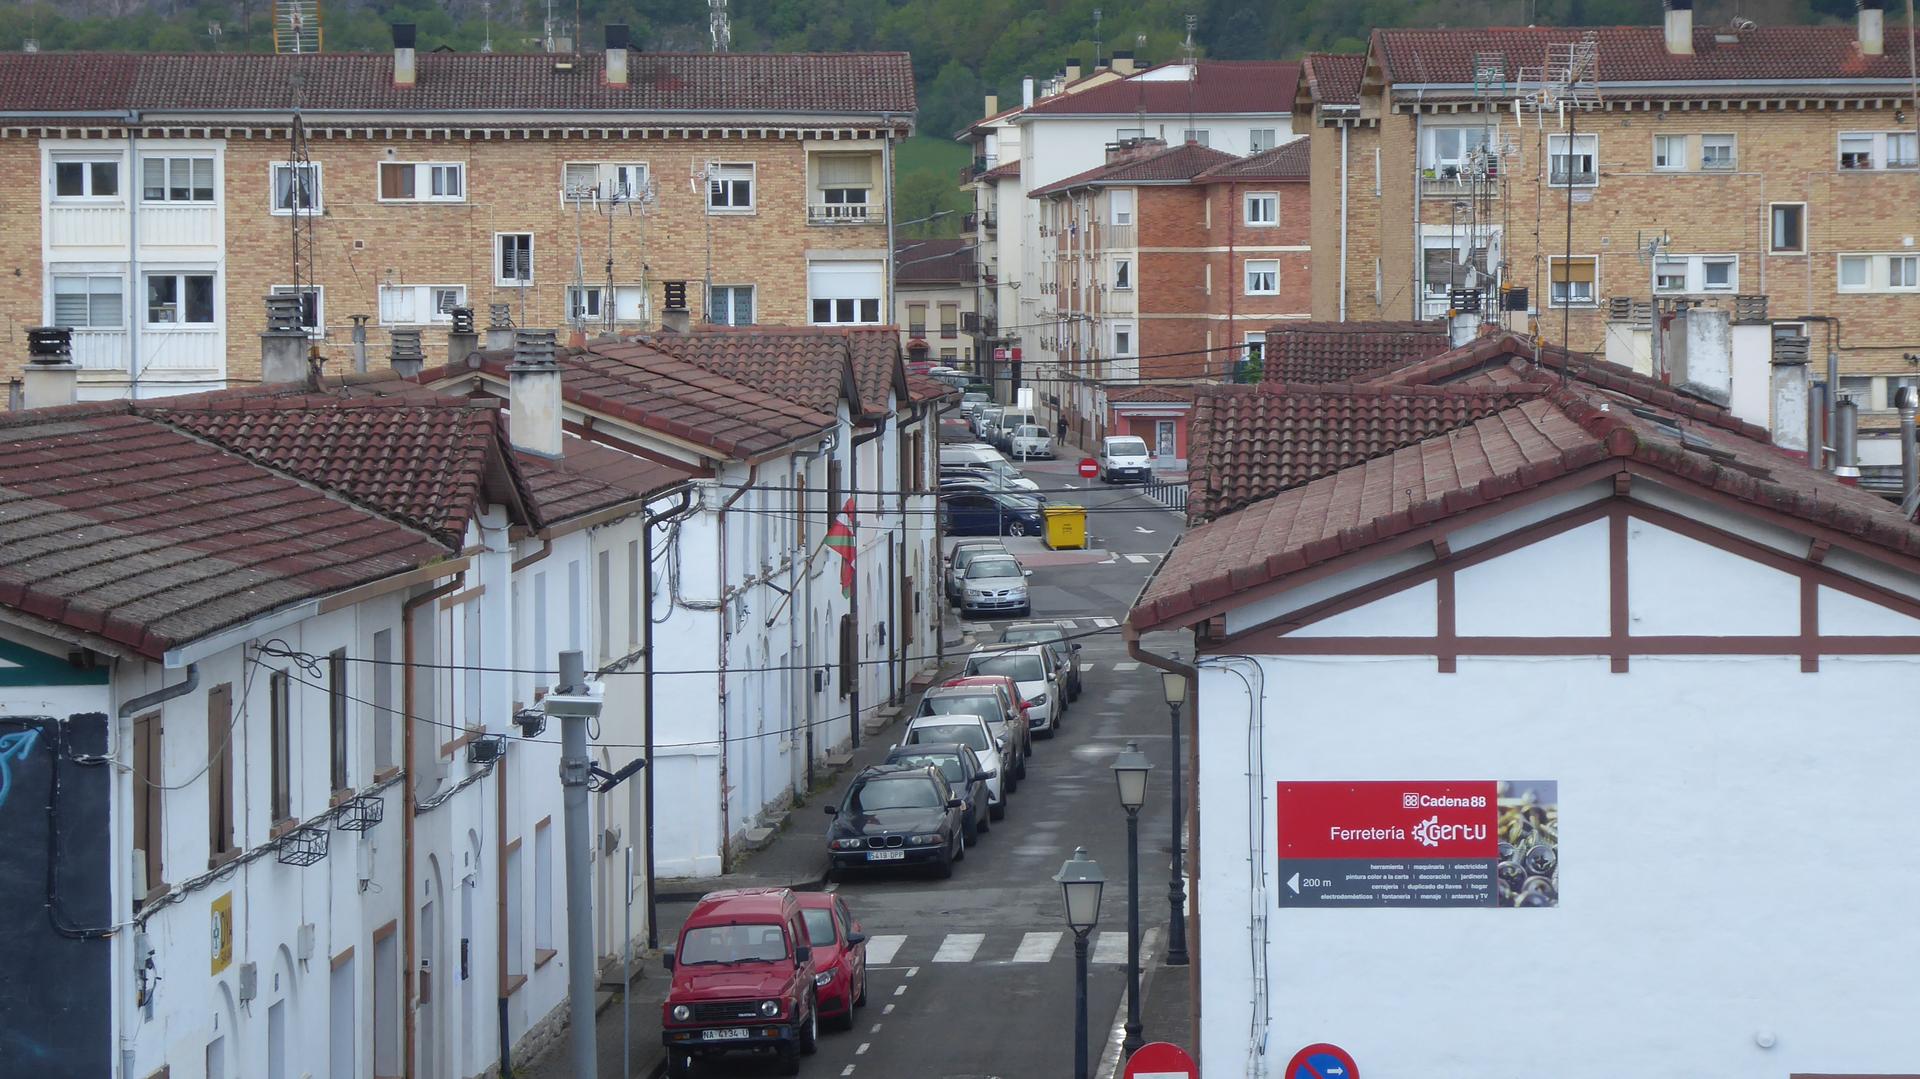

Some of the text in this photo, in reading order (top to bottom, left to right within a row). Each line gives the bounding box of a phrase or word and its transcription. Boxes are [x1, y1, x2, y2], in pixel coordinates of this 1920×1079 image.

[1330, 825, 1405, 840] Ferretería
[1303, 878, 1321, 887] 200
[1407, 883, 1436, 891] duplicado
